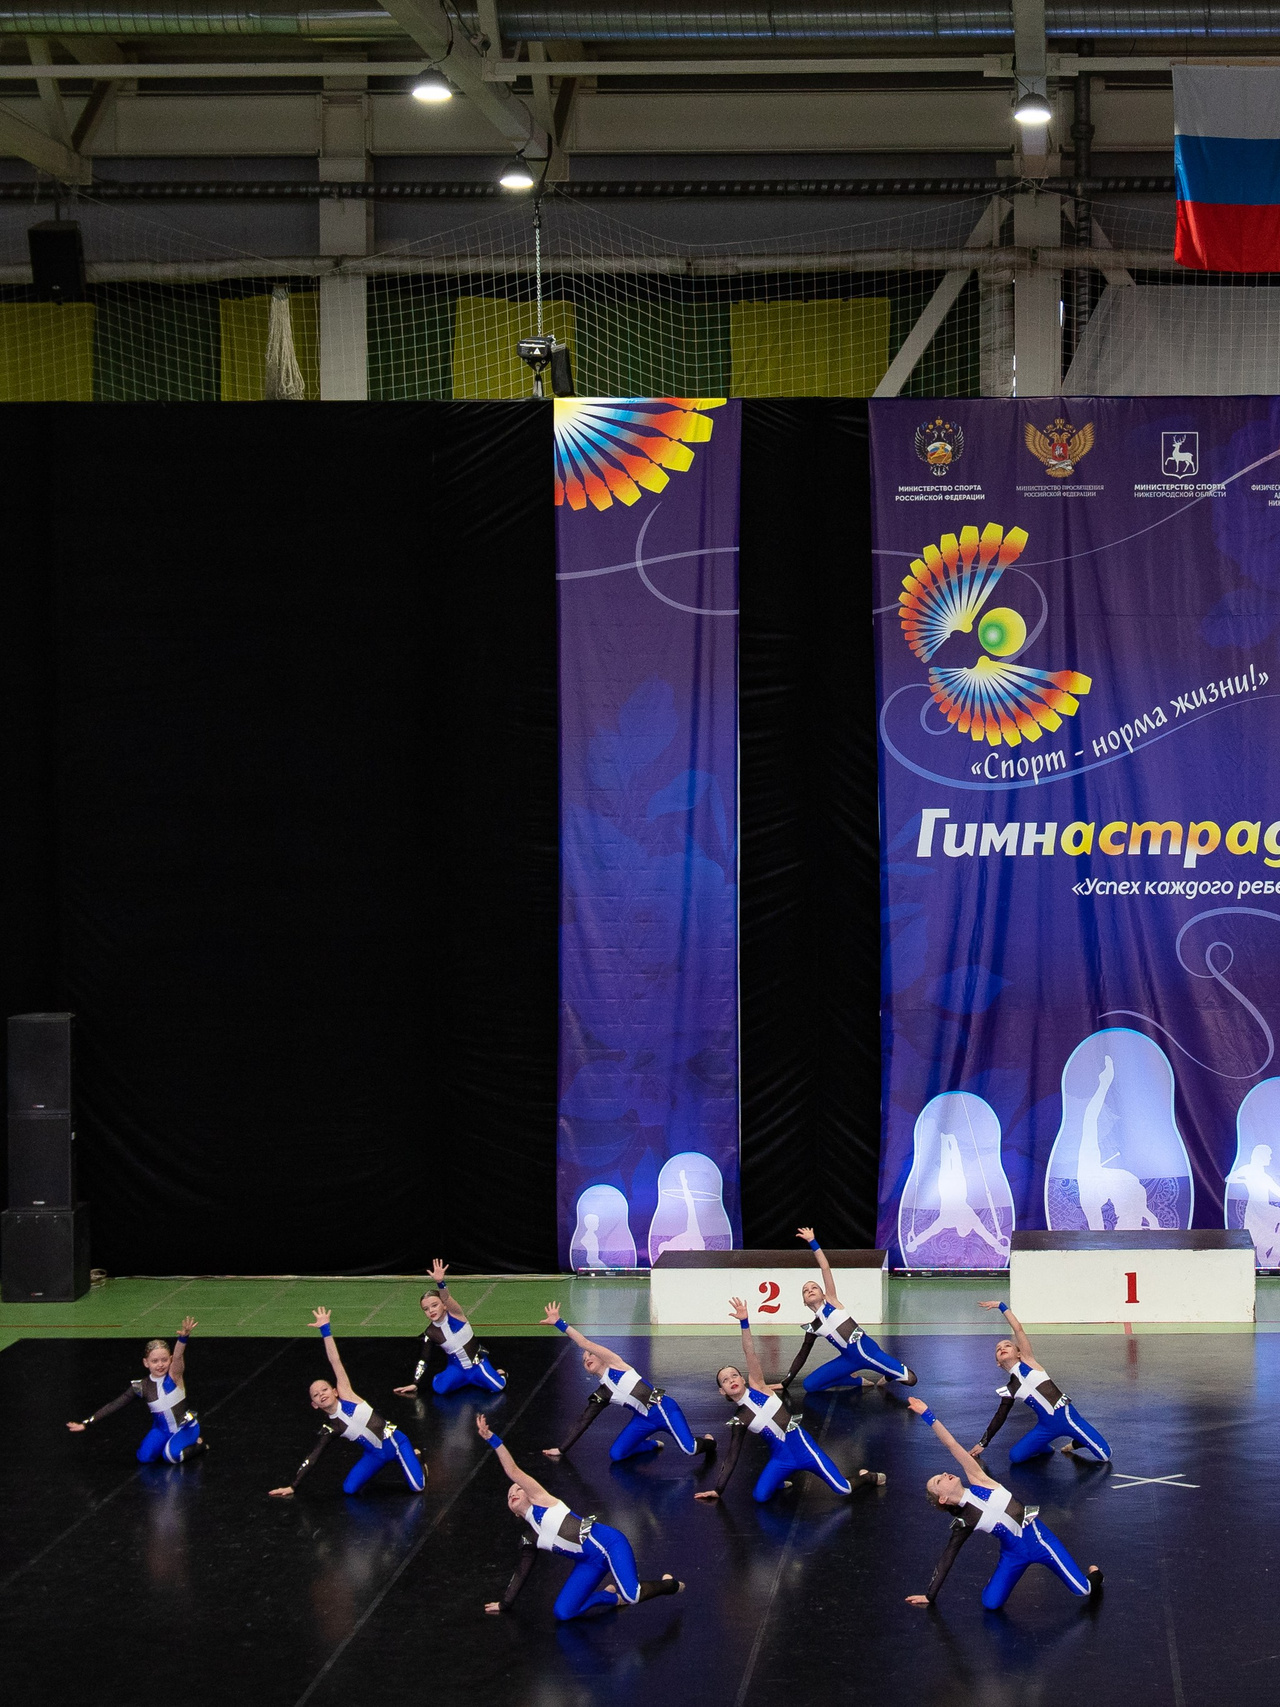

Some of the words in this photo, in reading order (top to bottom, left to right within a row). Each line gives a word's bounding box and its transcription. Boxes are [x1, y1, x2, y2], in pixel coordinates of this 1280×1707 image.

[895, 493, 943, 501] РОССИЙСКОЙ
[944, 493, 985, 501] ФЕДЕРАЦИИ
[970, 750, 1067, 785] «Спорт
[1092, 706, 1168, 758] норма
[1170, 664, 1269, 718] жизни!»
[1071, 877, 1142, 896] «Успех
[1144, 880, 1234, 899] каждого
[758, 1281, 781, 1314] 2
[1124, 1272, 1140, 1303] 1
